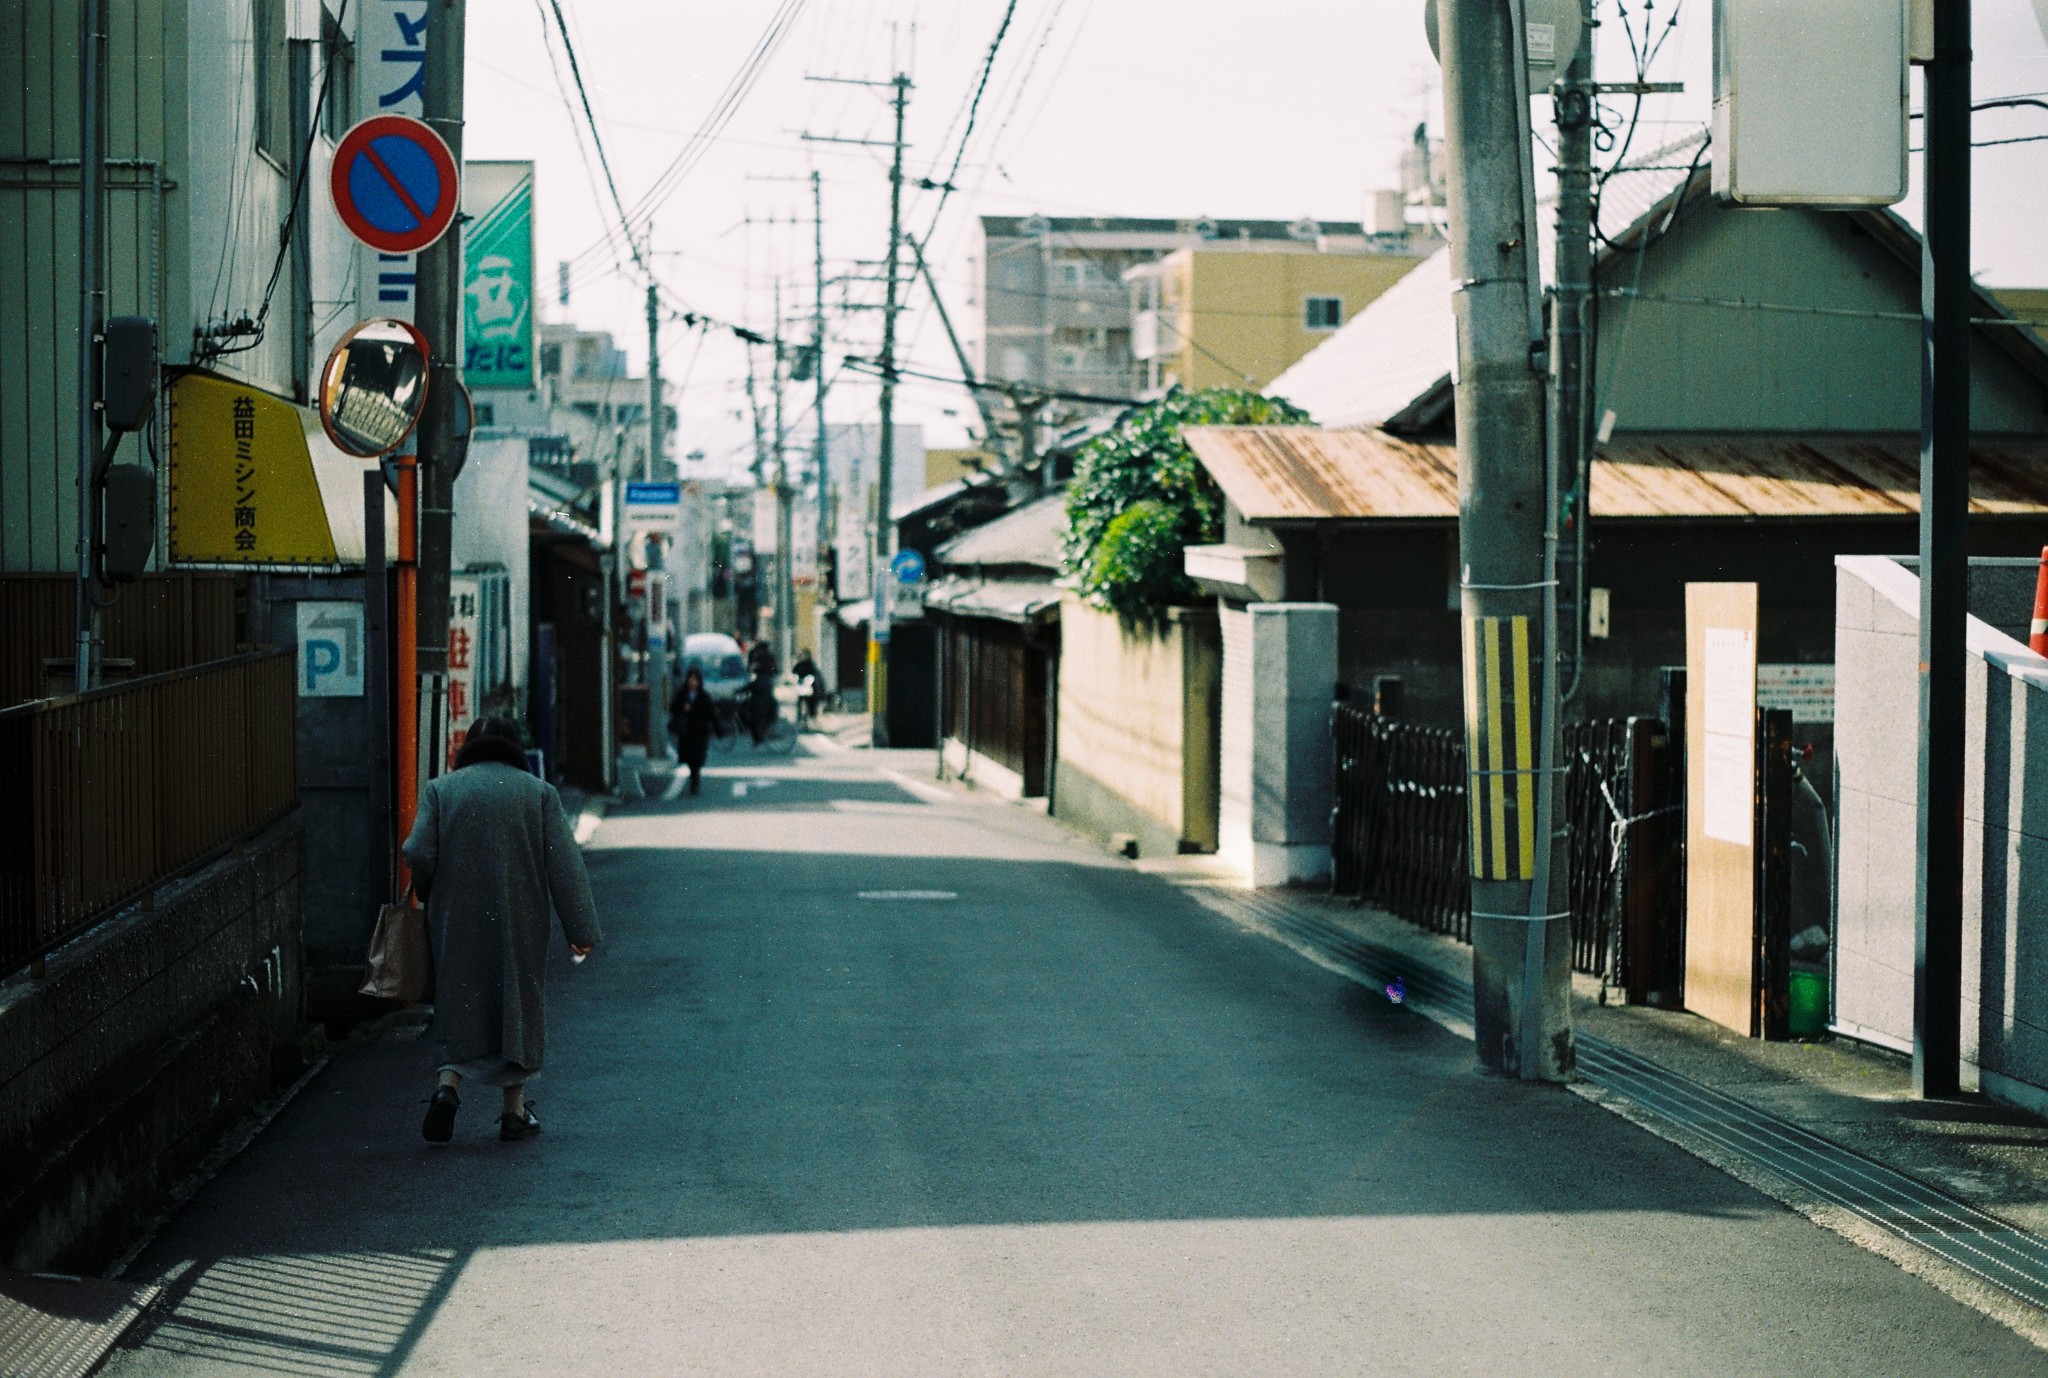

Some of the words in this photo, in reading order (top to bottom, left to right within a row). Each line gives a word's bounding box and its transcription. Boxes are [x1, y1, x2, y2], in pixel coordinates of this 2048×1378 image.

[233, 396, 256, 551] 益田ミシン商会
[306, 639, 341, 689] P
